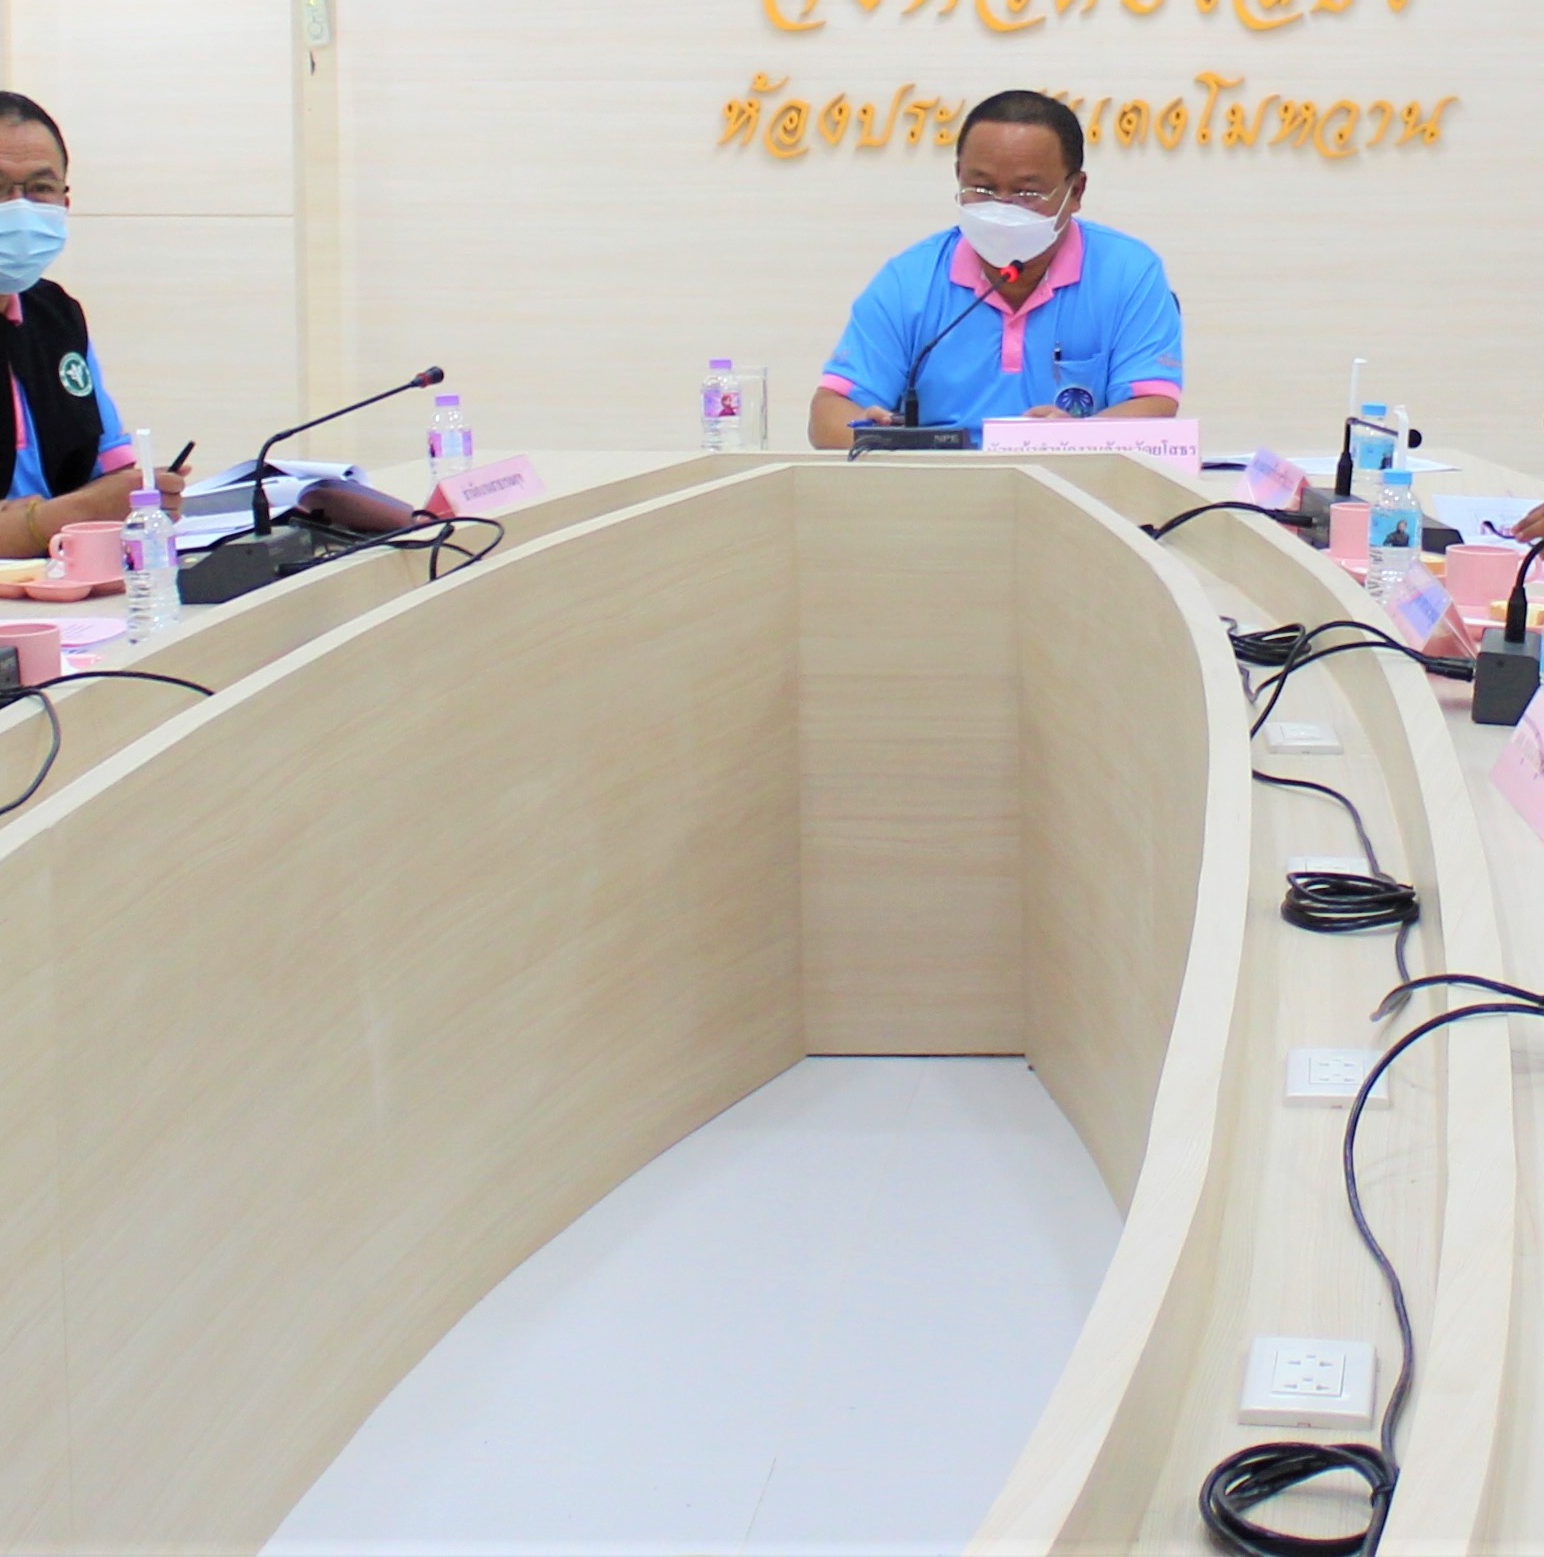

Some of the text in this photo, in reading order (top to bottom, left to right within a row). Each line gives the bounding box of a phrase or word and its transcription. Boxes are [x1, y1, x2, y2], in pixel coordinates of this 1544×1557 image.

[716, 71, 1459, 158] ห้องประแตงโมหวาน
